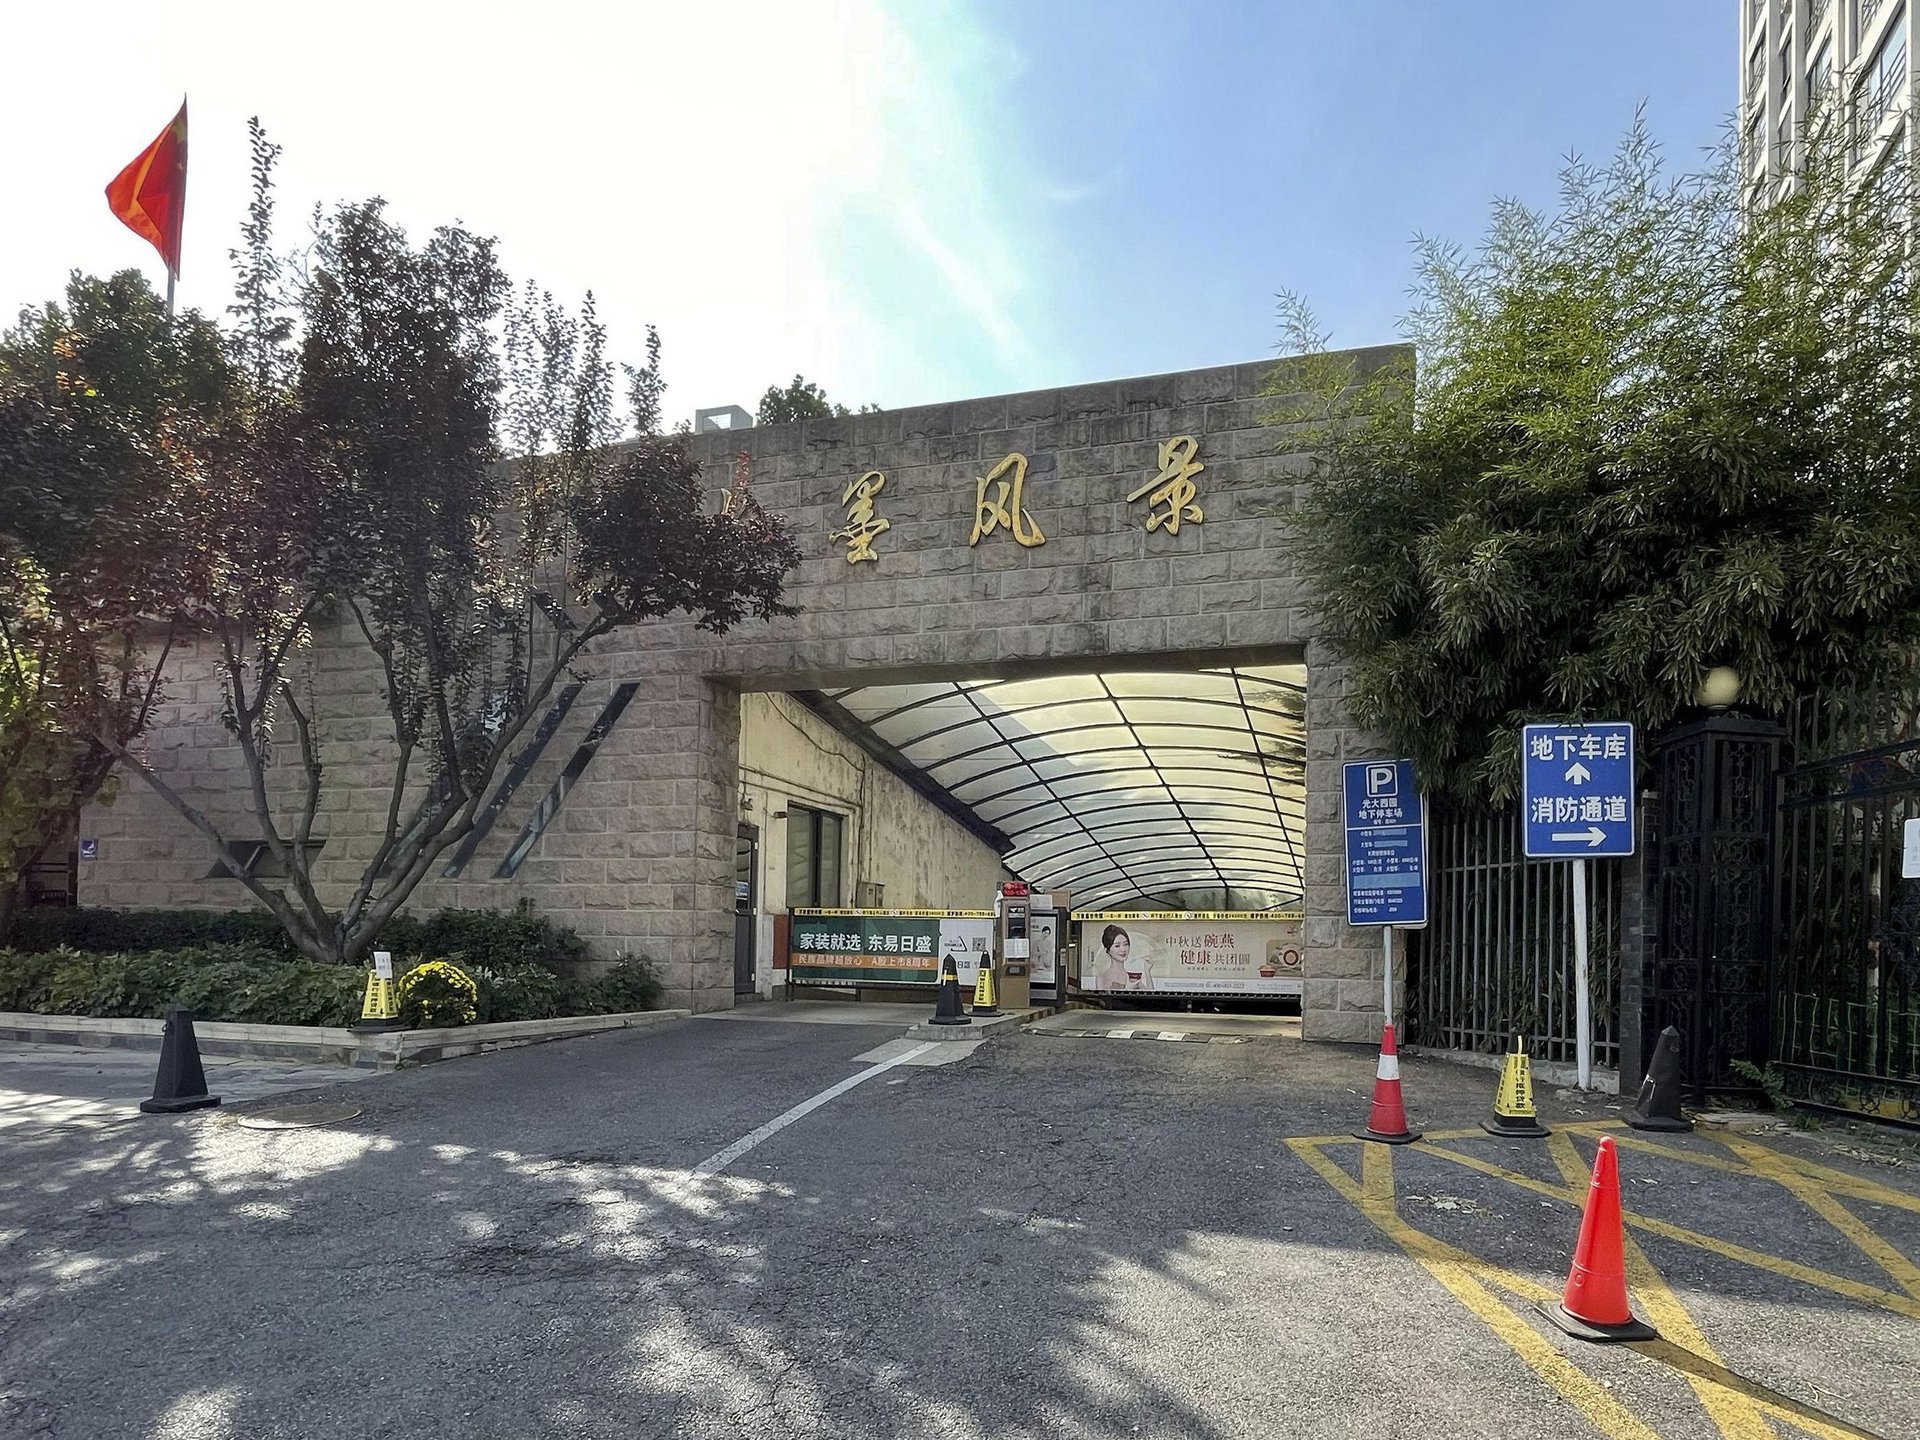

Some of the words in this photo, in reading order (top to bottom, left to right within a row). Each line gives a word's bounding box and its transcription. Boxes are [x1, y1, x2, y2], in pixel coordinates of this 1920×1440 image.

[1530, 733, 1627, 761] 地下车库
[1370, 767, 1393, 794] P
[1358, 808, 1403, 819] 地下停车场
[1531, 795, 1627, 824] 消防通道
[799, 932, 862, 952] 家装就选
[867, 935, 932, 954] 东易日盛
[1165, 932, 1235, 949] 中秋送碗燕
[798, 953, 863, 966] 民族品牌超放心
[871, 956, 931, 969] A股上市8周年
[1180, 949, 1251, 966] 健康共团圆
